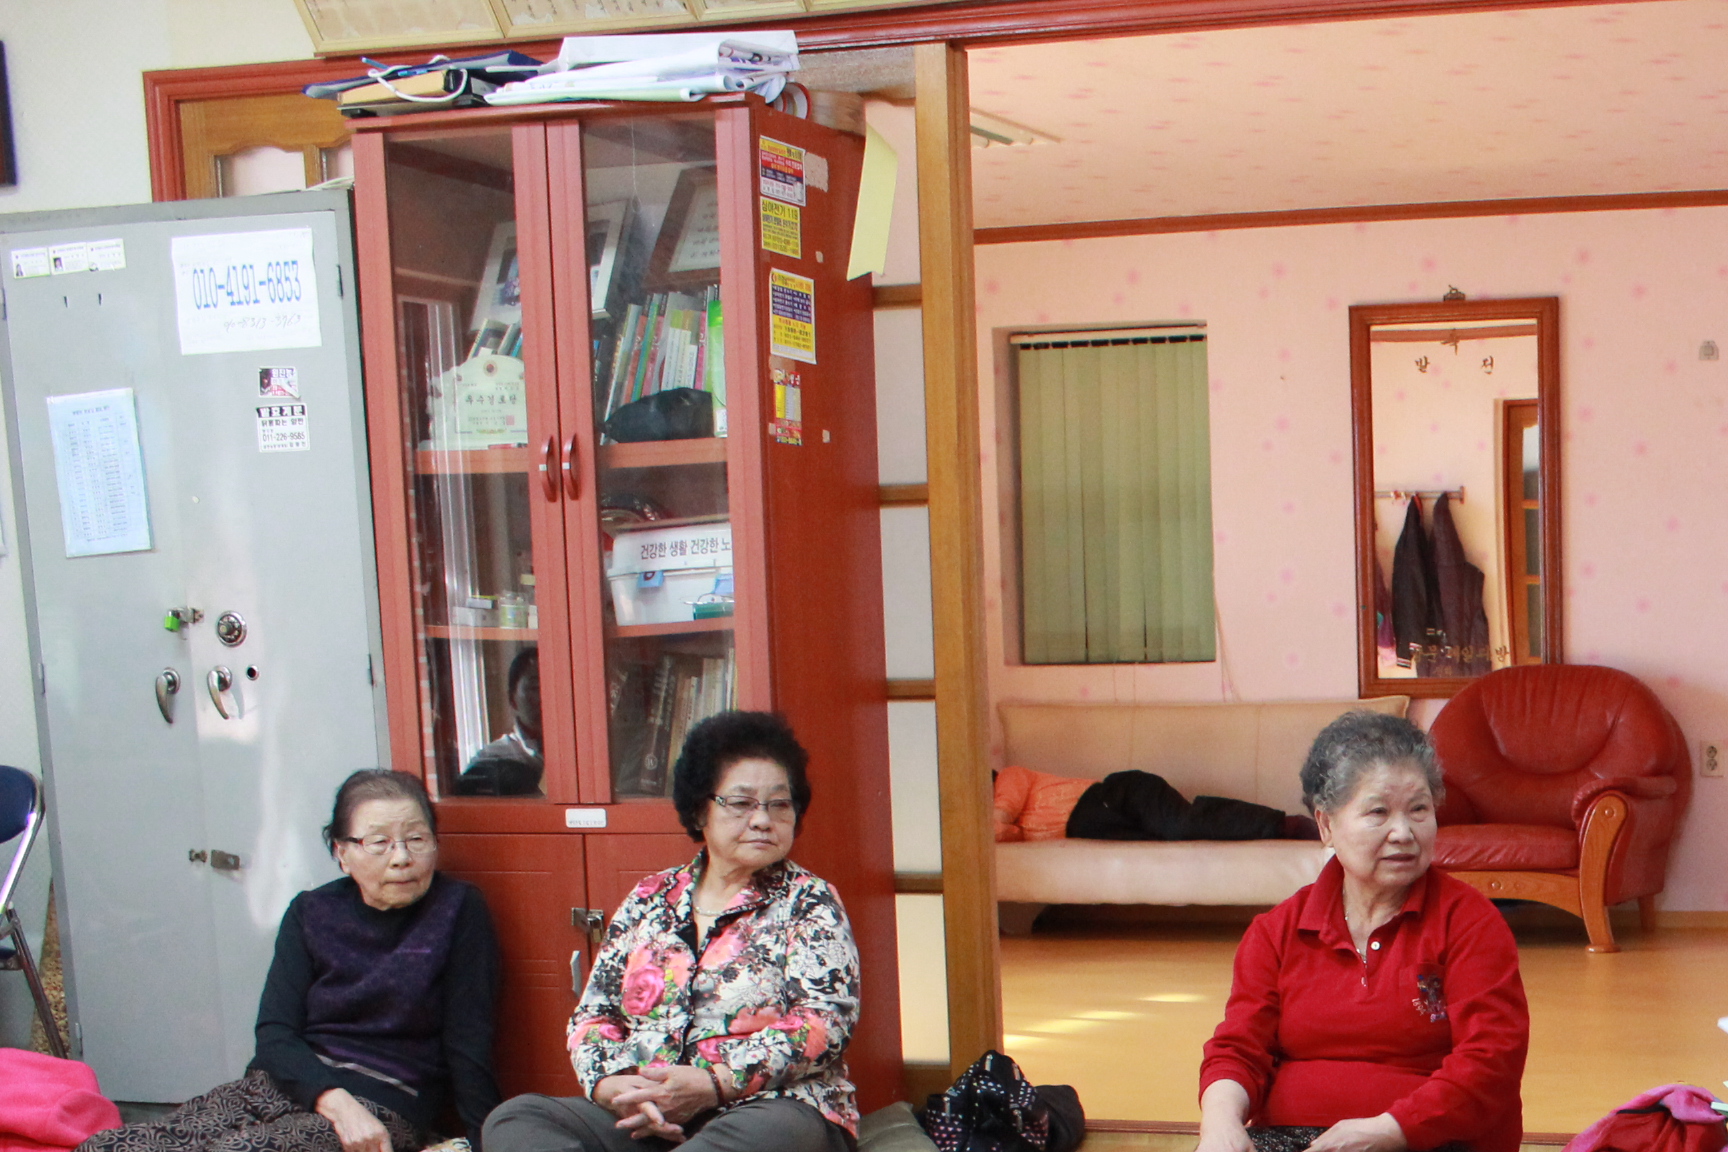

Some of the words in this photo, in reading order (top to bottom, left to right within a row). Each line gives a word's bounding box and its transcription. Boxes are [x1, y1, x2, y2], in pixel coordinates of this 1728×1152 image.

[193, 260, 301, 310] 010-4191-6853
[641, 542, 667, 560] 건강한
[669, 540, 688, 556] 생활
[690, 538, 719, 555] 건강한
